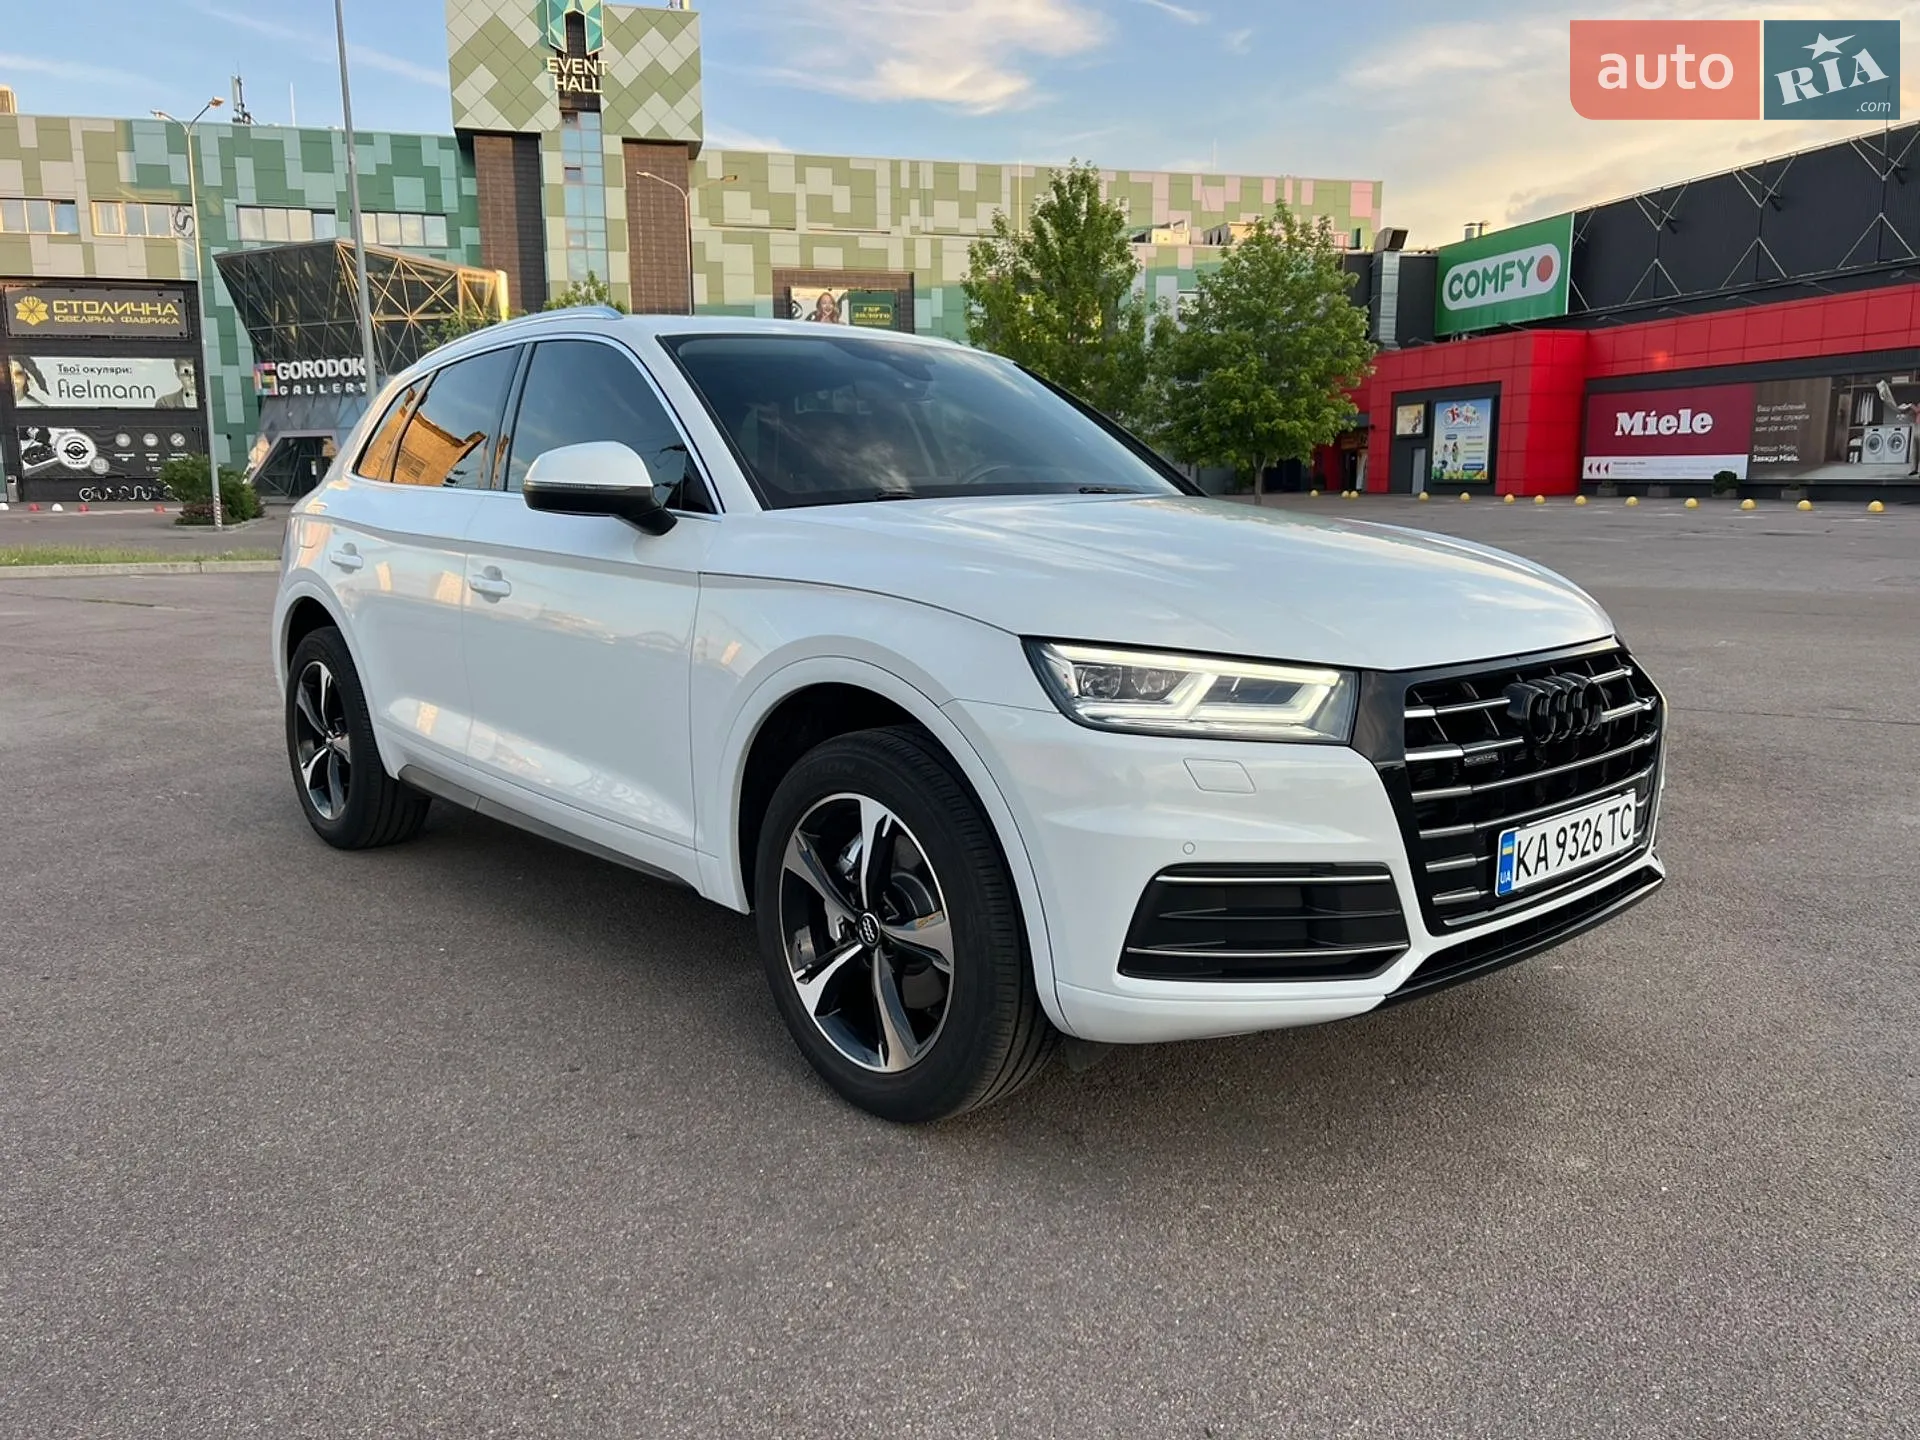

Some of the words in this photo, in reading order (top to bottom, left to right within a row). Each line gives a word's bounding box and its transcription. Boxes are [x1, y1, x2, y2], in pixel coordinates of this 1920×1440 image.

[546, 57, 608, 76] EVENT
[554, 76, 604, 93] HALL
[1448, 255, 1535, 302] COMFY
[53, 300, 178, 316] СТОЛИЧНА
[120, 316, 180, 325] ФАБРИКА
[276, 357, 366, 380] GORODOK
[1614, 409, 1714, 437] Miele
[1515, 832, 1549, 881] KA
[1556, 813, 1603, 867] 9326
[1608, 803, 1632, 846] TC
[1500, 871, 1511, 884] UA
